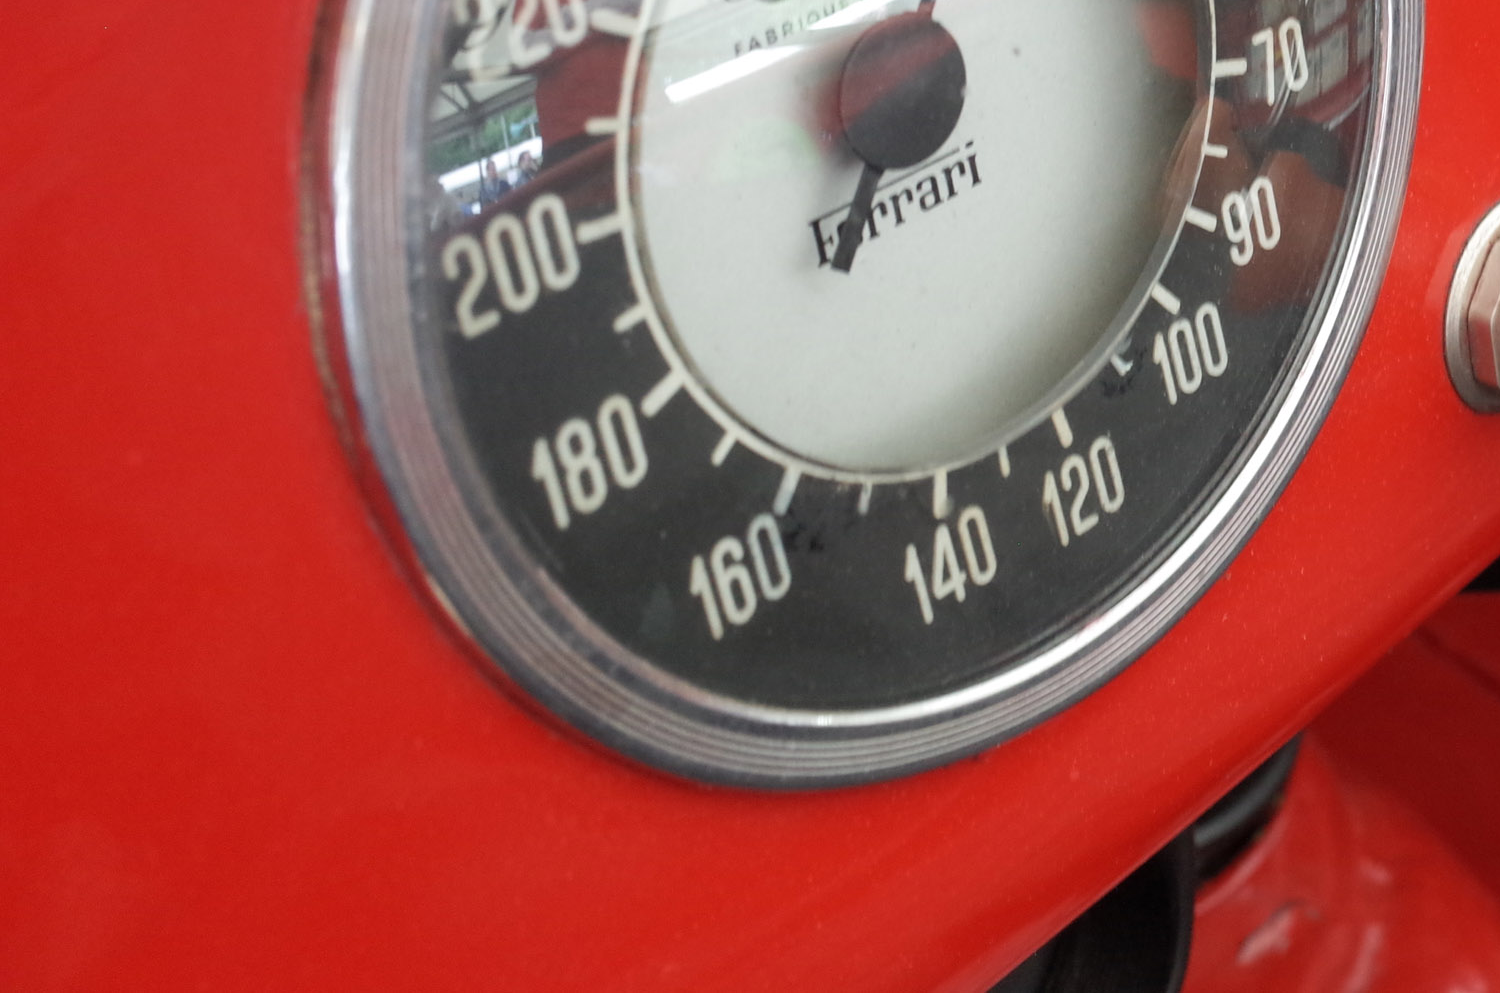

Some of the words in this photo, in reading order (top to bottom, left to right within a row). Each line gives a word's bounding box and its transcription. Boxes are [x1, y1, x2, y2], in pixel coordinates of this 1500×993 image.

[1251, 15, 1309, 107] 70
[443, 192, 581, 340] 200
[1221, 177, 1282, 267] 90
[1151, 299, 1229, 405] 100
[531, 393, 650, 531] 180
[1040, 435, 1127, 549] 120
[688, 514, 794, 641] 160
[904, 505, 998, 625] 140
